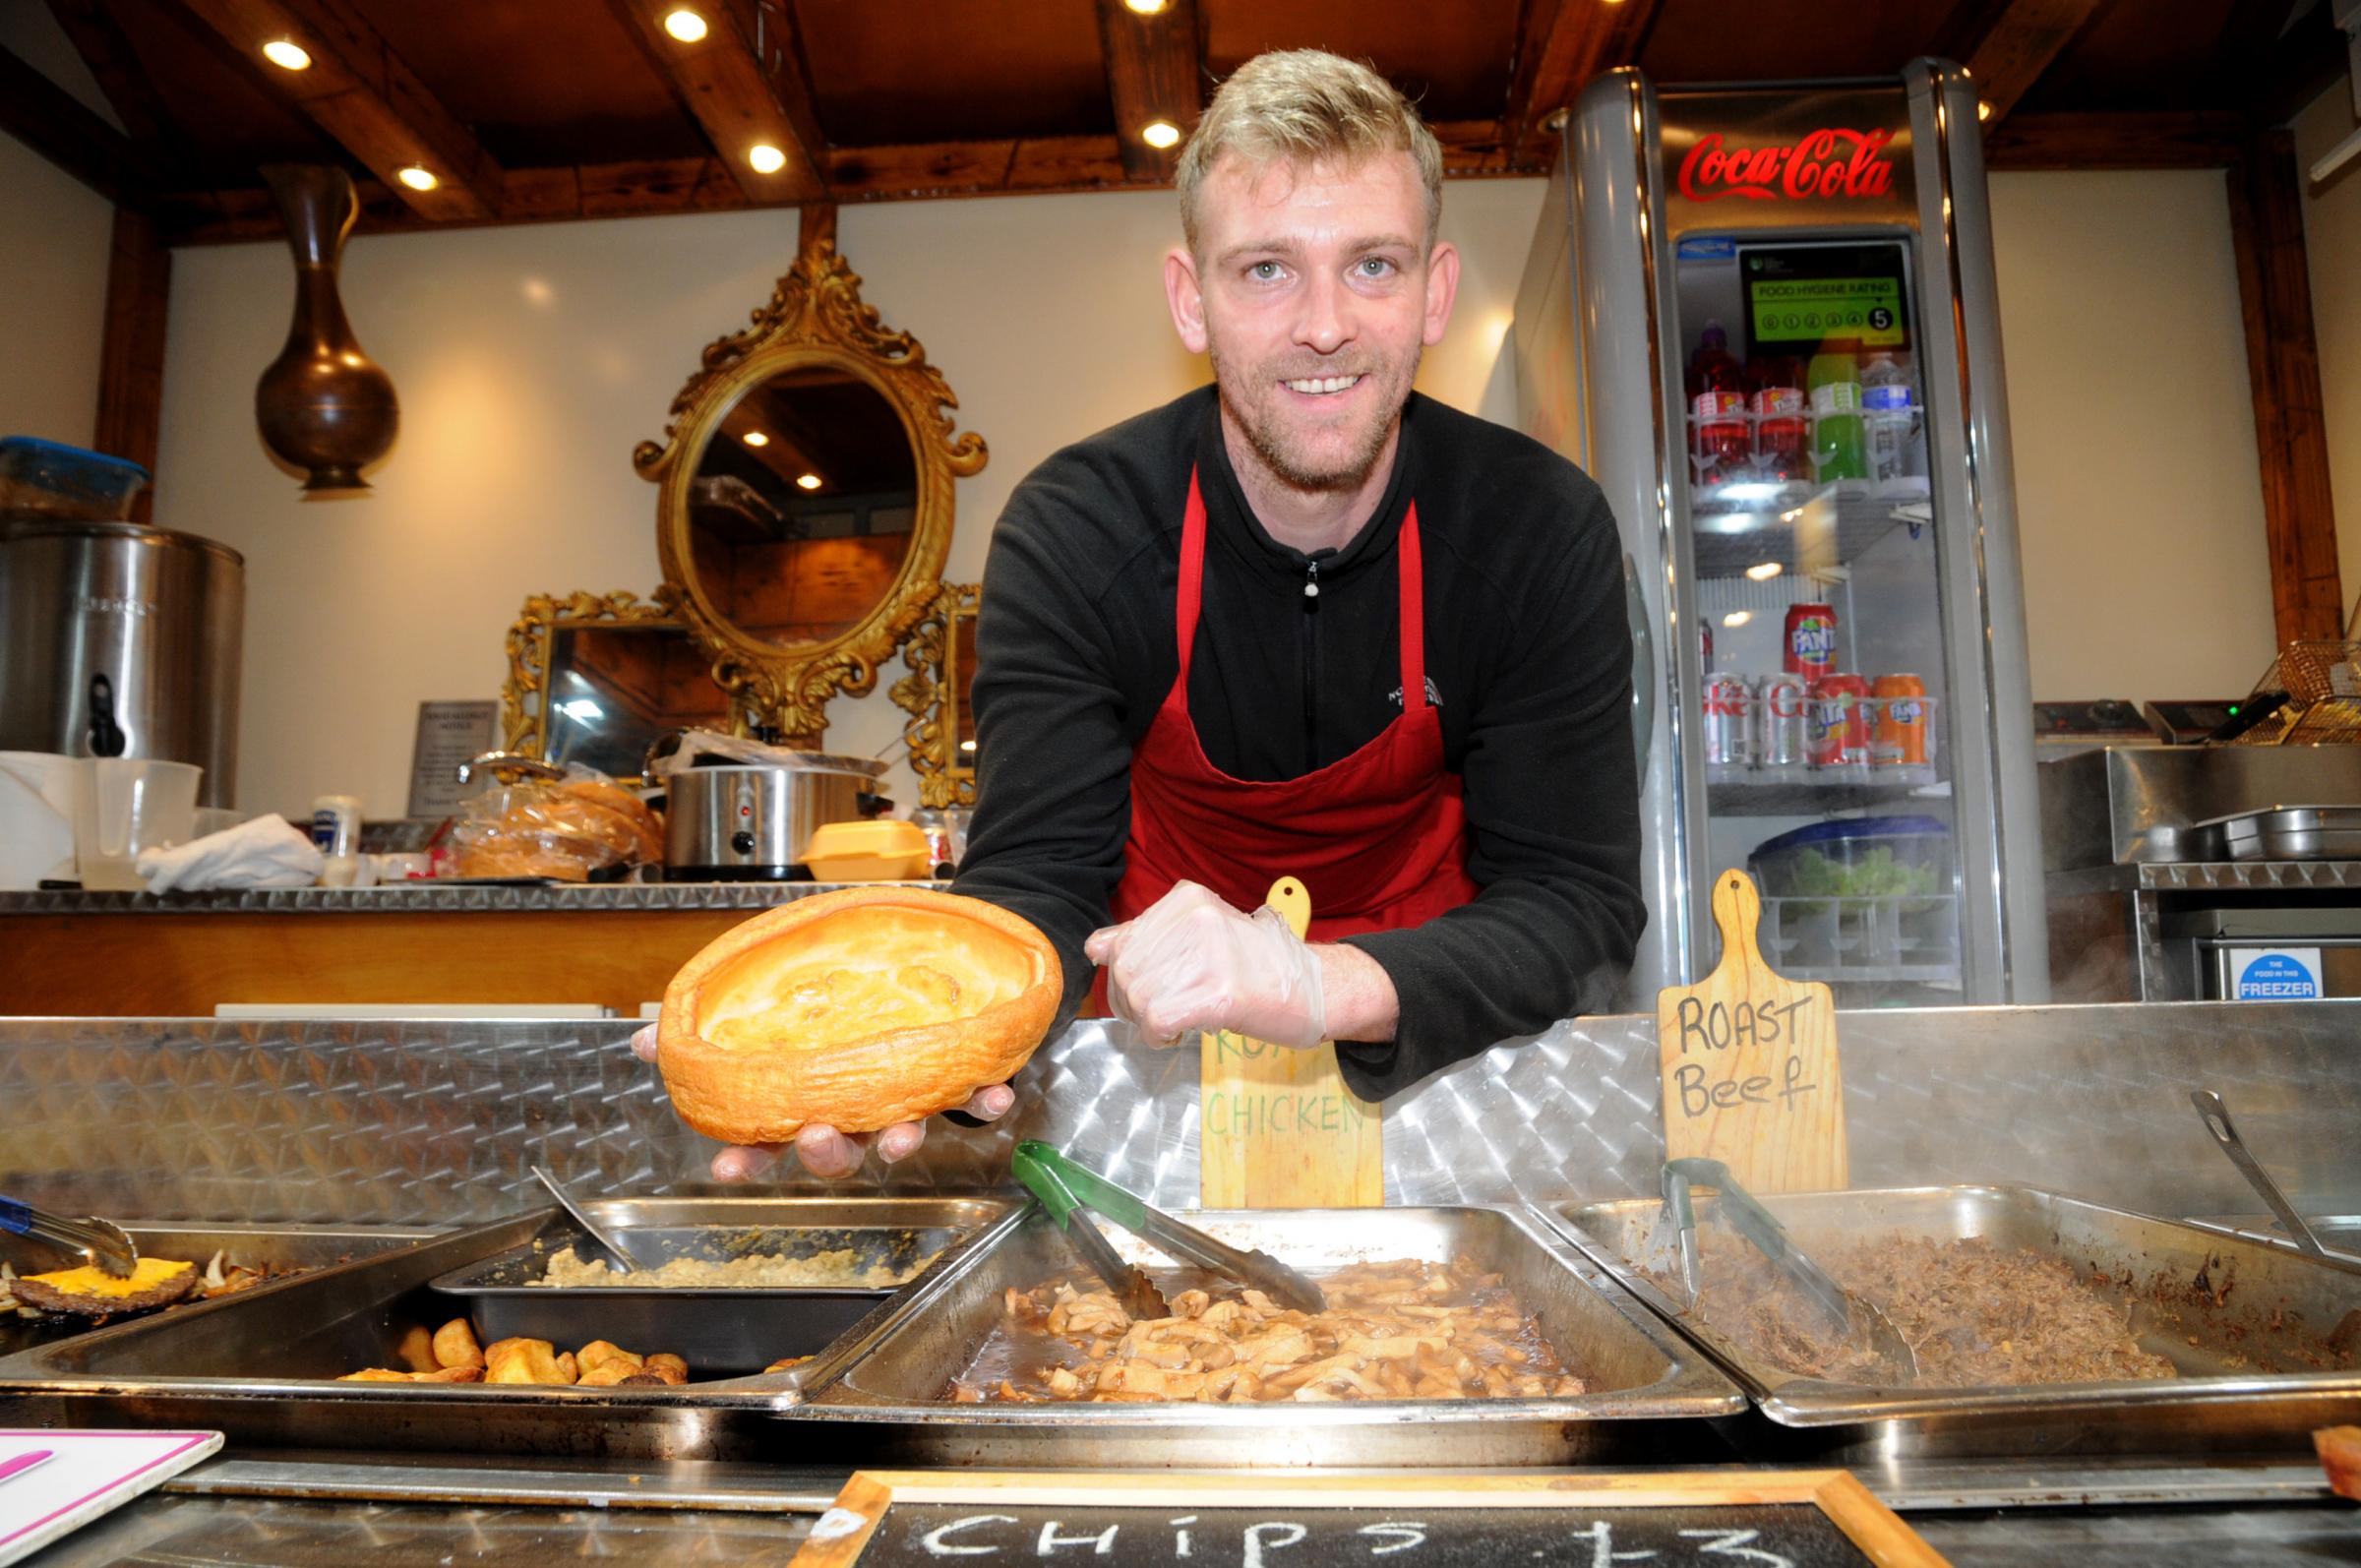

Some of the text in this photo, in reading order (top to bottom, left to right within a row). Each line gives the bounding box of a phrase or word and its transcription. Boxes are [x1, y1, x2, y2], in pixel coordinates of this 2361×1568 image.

[1759, 281, 1892, 297] FOOD HYGIENE RATING
[1873, 309, 1889, 329] 5
[2240, 982, 2314, 996] FREEZER
[1677, 996, 1813, 1054] ROAST
[1674, 1055, 1817, 1118] Beef
[1206, 1092, 1366, 1135] CHICKEN
